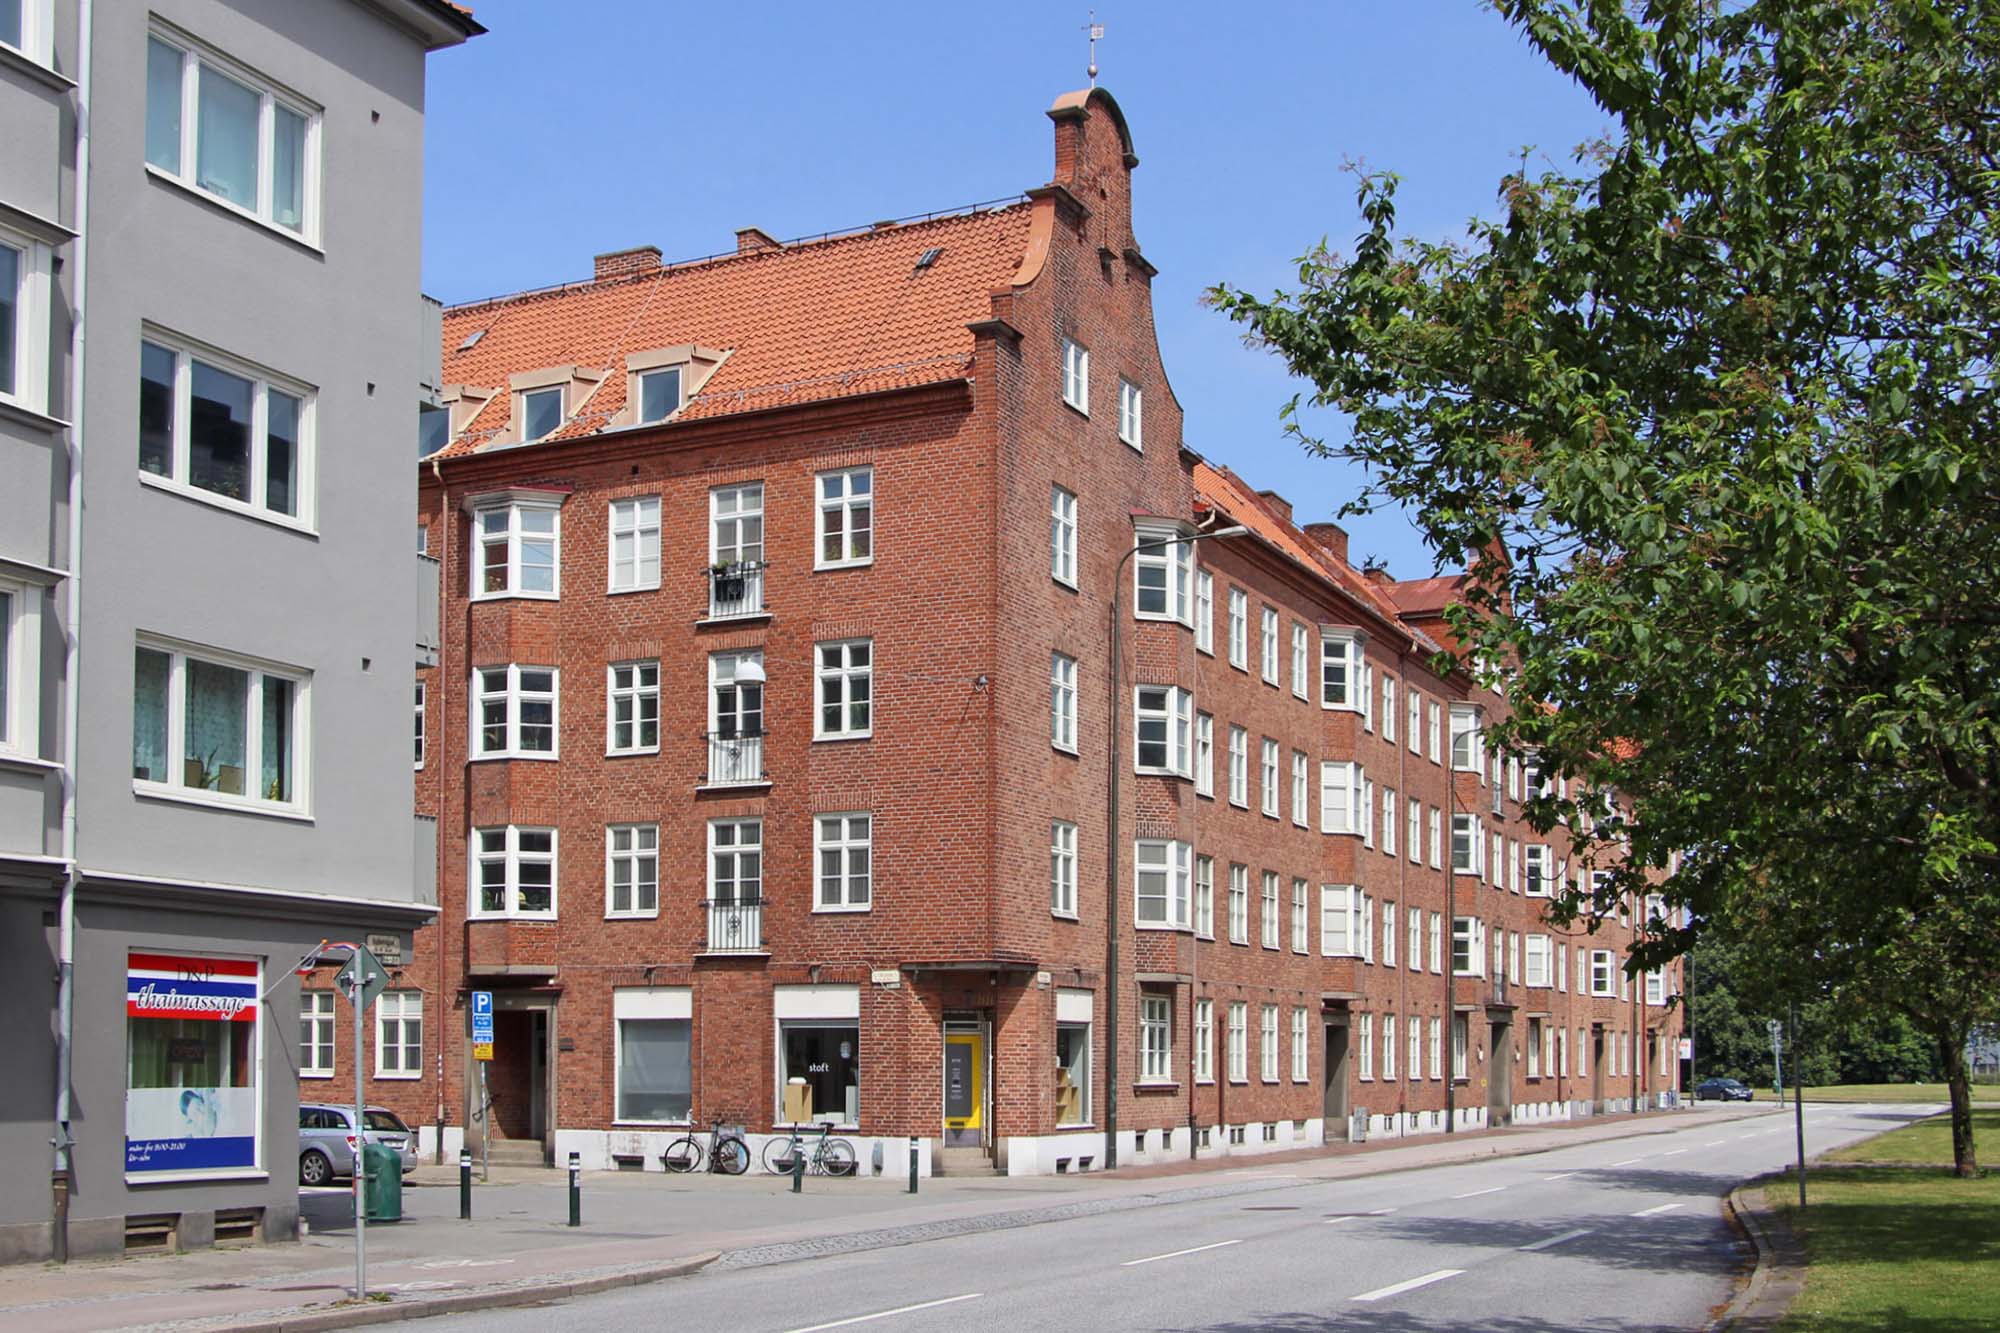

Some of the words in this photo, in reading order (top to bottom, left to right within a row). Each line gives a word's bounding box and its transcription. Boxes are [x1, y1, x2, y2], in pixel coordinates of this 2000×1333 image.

[177, 964, 215, 984] D&P
[137, 983, 245, 1019] thaimassage
[477, 994, 489, 1012] P
[809, 1062, 830, 1072] stoft
